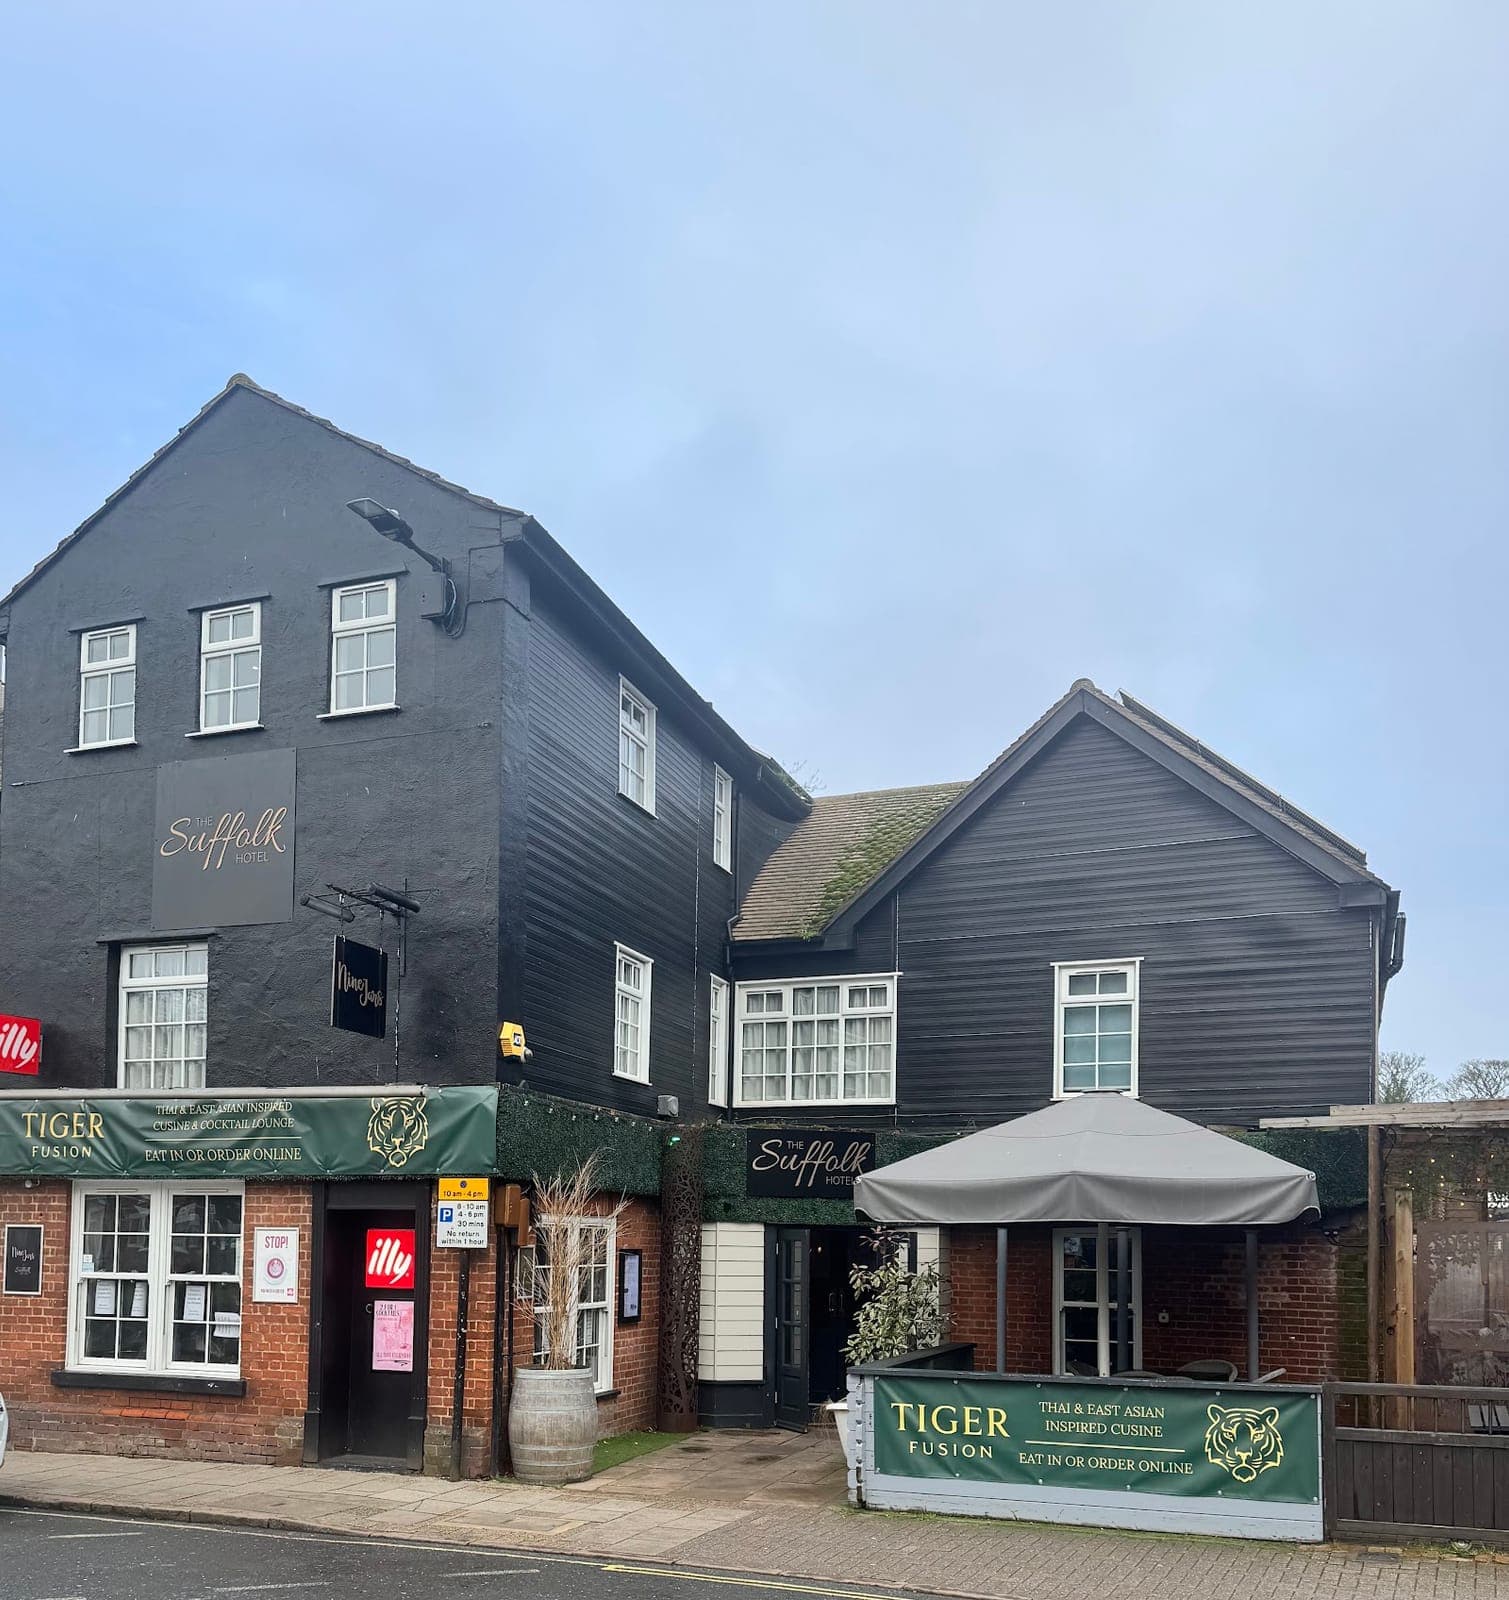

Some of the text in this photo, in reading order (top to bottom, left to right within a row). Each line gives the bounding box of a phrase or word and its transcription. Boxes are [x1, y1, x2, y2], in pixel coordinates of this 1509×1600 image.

[195, 815, 214, 828] THE
[160, 806, 288, 871] Suffolk
[235, 851, 269, 864] HOTEL
[338, 960, 365, 993] Nine
[360, 979, 384, 1008] Jars
[0, 1022, 38, 1069] illy
[155, 1101, 293, 1115] THAI & EAST ASIAN INSPIRED
[21, 1111, 105, 1139] TIGER
[153, 1118, 295, 1131] CUSINE & COCKTAIL LOUNGE
[32, 1145, 92, 1159] FUSION
[786, 1140, 805, 1150] THE
[145, 1147, 302, 1162] EAT IN OR ORDER ONLINE
[752, 1139, 872, 1188] Suffolk
[443, 1209, 452, 1221] P
[264, 1235, 289, 1249] STOP!
[367, 1237, 412, 1285] illy
[1038, 1401, 1165, 1419] THAI & EAST ASIAN
[890, 1402, 1010, 1438] TIGER
[1045, 1420, 1163, 1437] INSPIRED CUSINE
[909, 1440, 993, 1459] FUSION
[1019, 1452, 1194, 1475] EAT IN OR ORDER ONLINE
